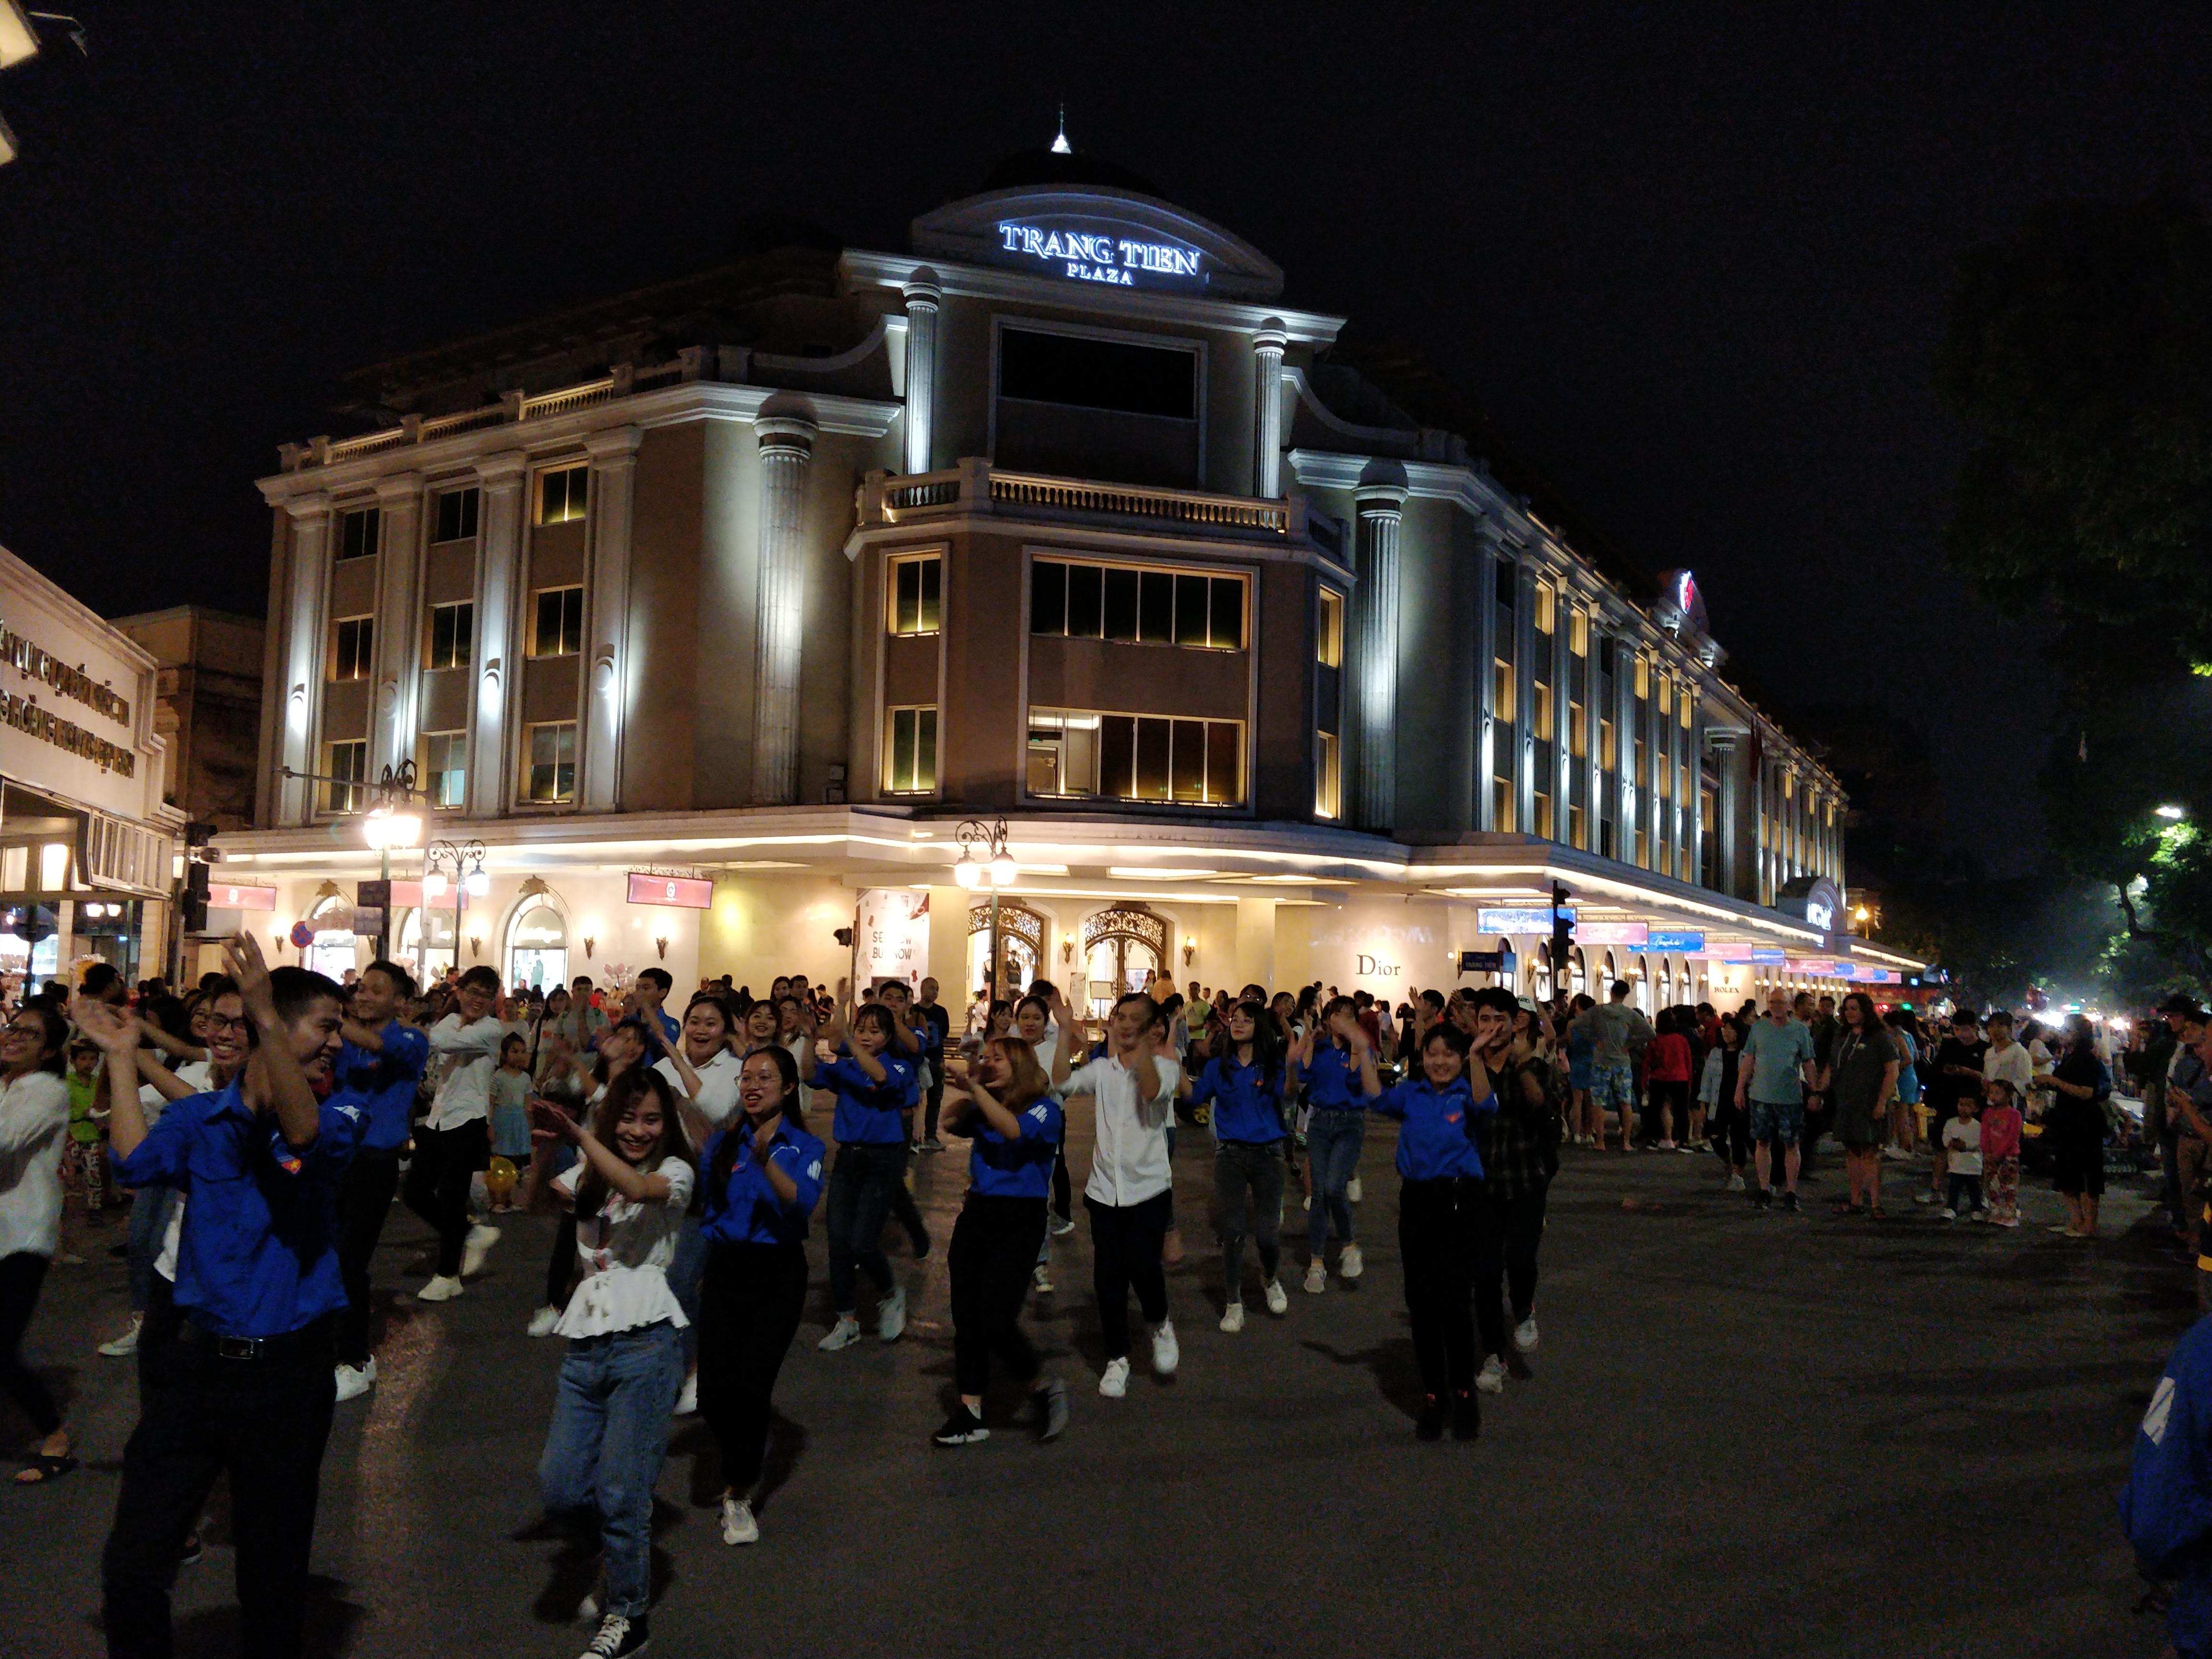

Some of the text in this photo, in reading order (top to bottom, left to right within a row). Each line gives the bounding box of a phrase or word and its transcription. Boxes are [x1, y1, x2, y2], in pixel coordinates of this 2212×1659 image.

[999, 223, 1201, 276] TRANG TIEN
[1067, 262, 1133, 286] PLAZA
[872, 931, 887, 943] SE
[872, 947, 886, 959] BU
[1356, 954, 1400, 975] Dior
